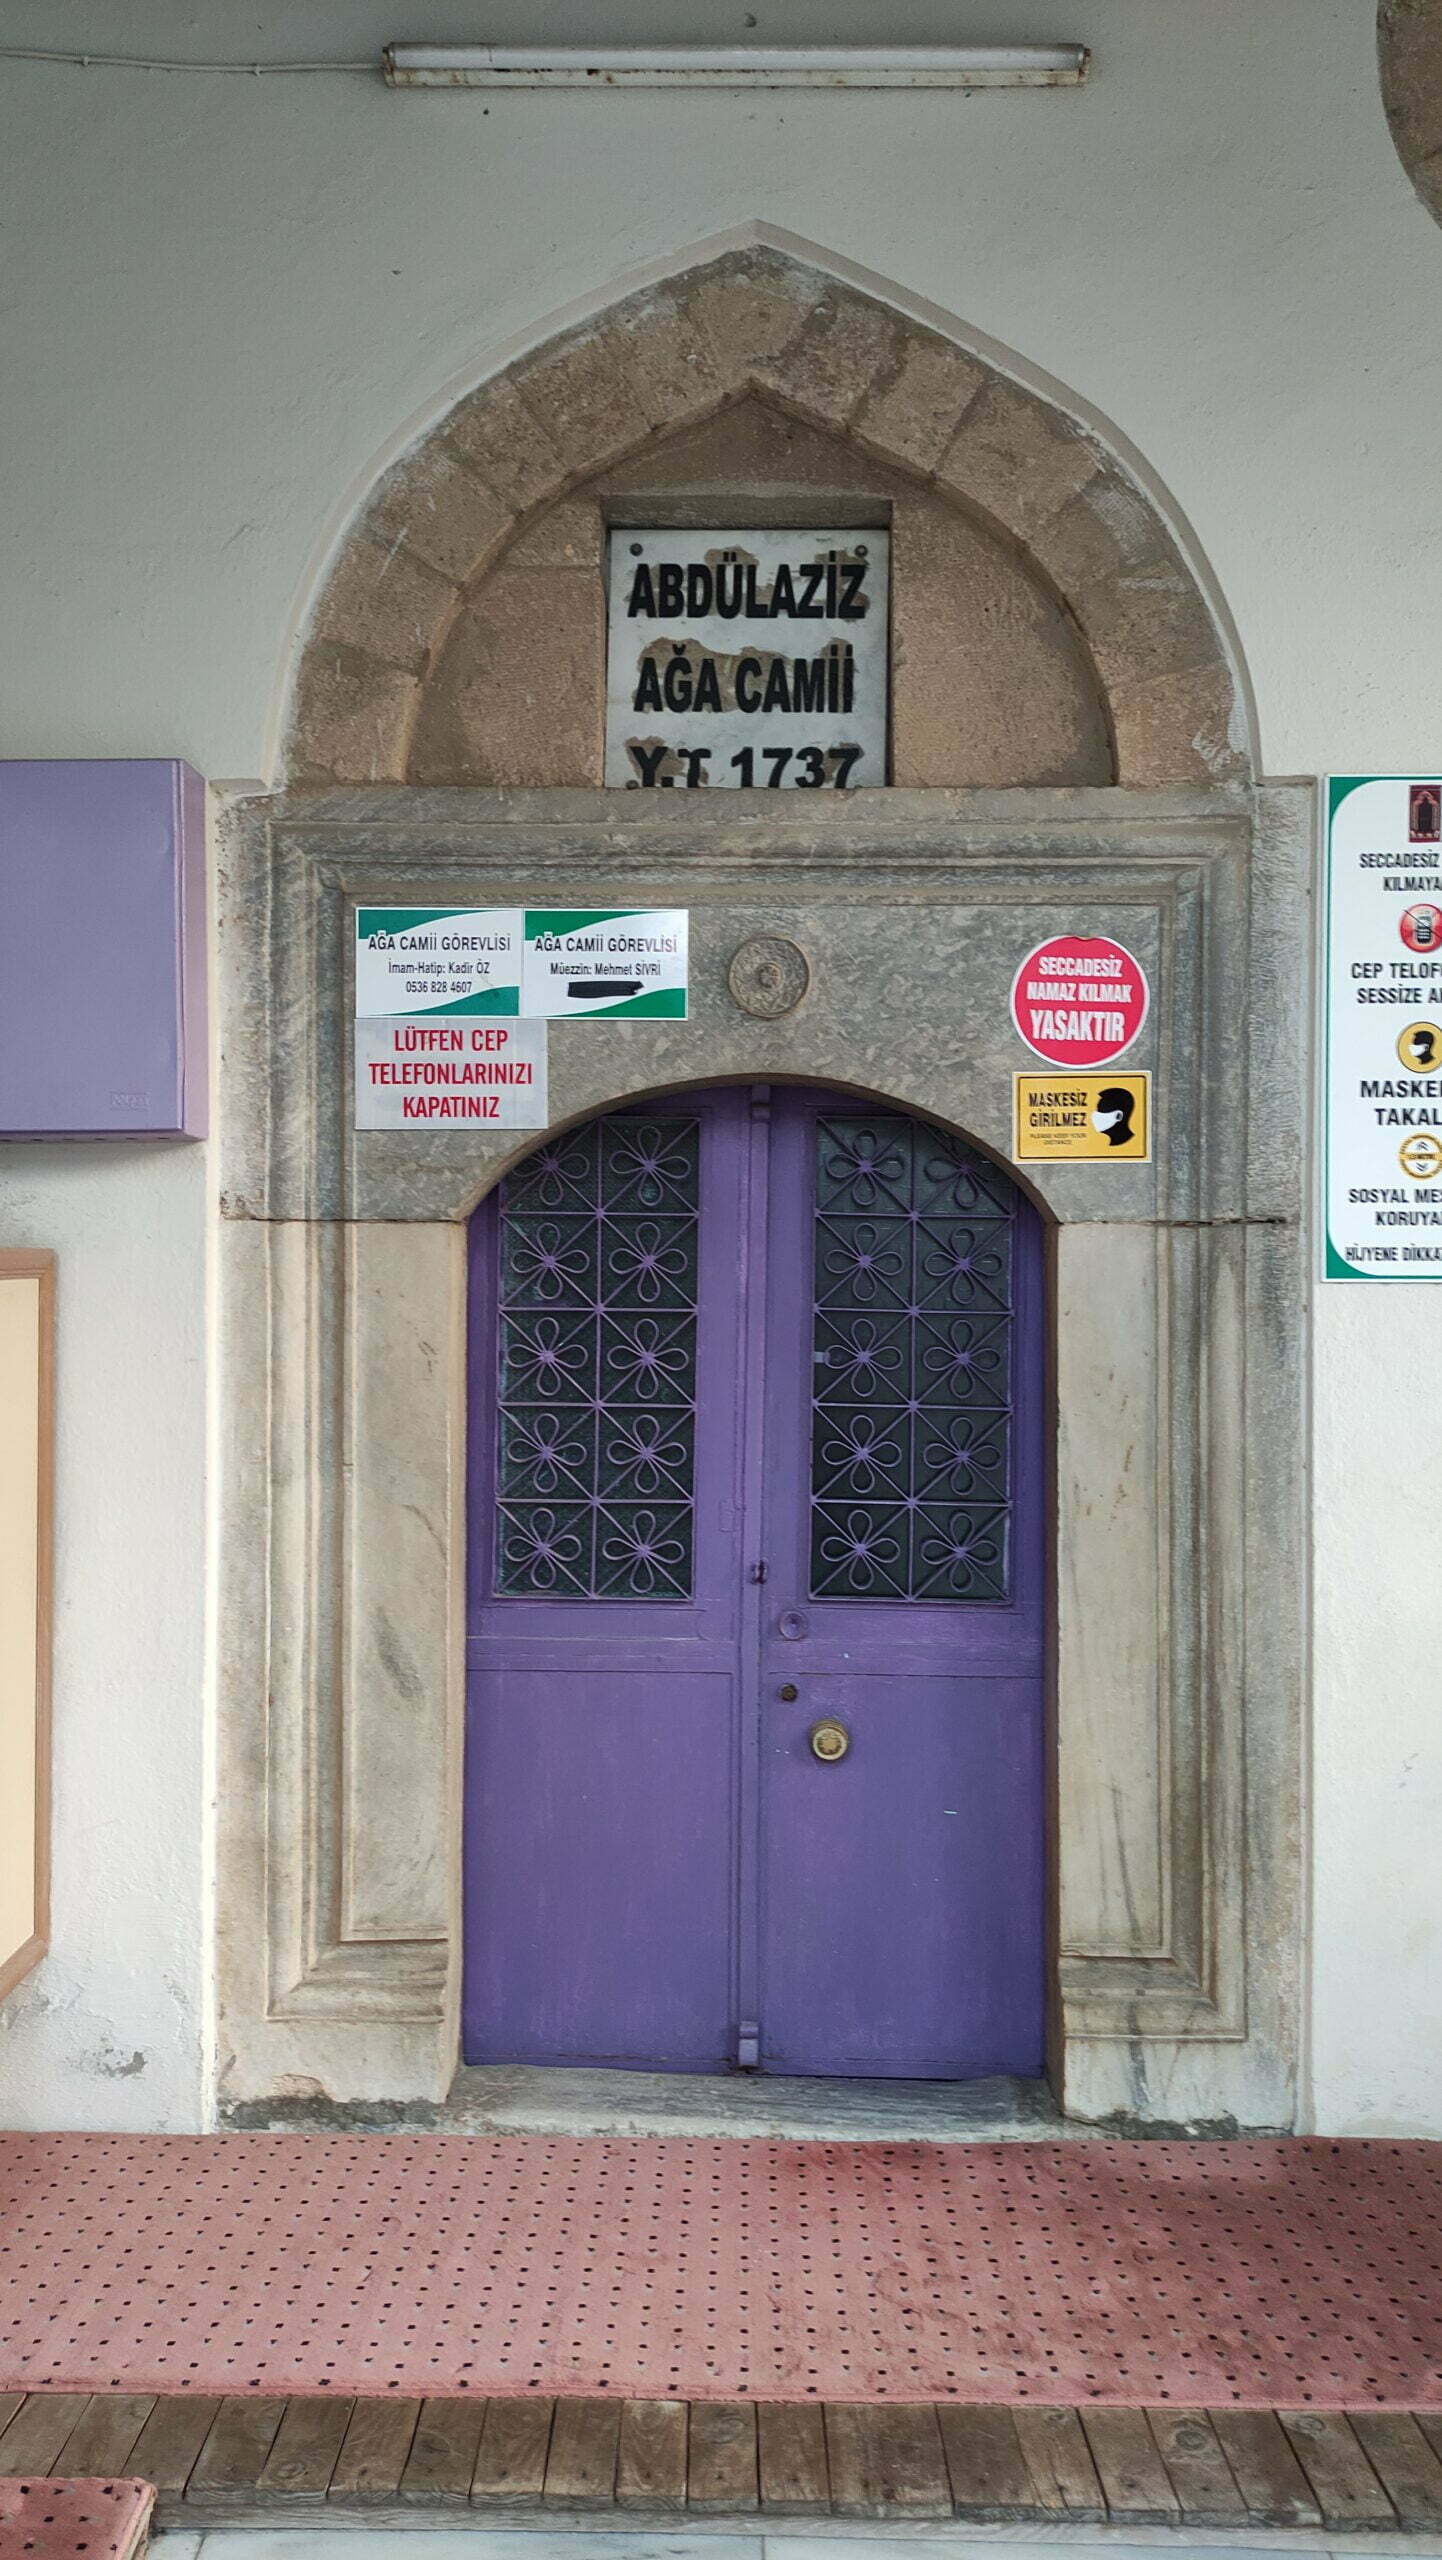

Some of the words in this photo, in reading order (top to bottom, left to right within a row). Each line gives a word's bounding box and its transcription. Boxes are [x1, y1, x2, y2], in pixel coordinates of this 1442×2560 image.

[627, 550, 866, 619] ABDÜLAZİZ
[633, 643, 723, 713] AĞA
[735, 644, 854, 713] CAMİİ
[629, 746, 712, 788] Y.T
[731, 746, 864, 788] 1737
[1359, 849, 1440, 868] SECCADESİZ
[1383, 876, 1442, 891] KILMAYA
[368, 932, 396, 950] AĞA
[400, 932, 437, 950] CAMİİ
[441, 932, 511, 951] GÖREVLİSİ
[534, 934, 562, 951] AĞA
[566, 934, 603, 951] CAMİİ
[608, 934, 677, 952] GÖREVLİSİ
[388, 957, 446, 976] İmam-Hatip:
[448, 961, 473, 974] Kadir
[476, 958, 490, 974] ÖZ
[550, 961, 591, 975] Müezzin:
[594, 962, 633, 975] Mehmet
[635, 960, 661, 976] SİVRİ
[1039, 955, 1123, 977] SECCADESİZ
[1351, 963, 1383, 979] CEP
[1390, 962, 1442, 978] TELOF
[406, 981, 428, 993] 0536
[431, 981, 447, 993] 828
[450, 981, 472, 993] 4607
[1027, 982, 1076, 1001] NAMAZ
[1078, 983, 1132, 1003] KILMAK
[1357, 983, 1422, 1003] SESSİZE
[1428, 988, 1442, 1003] A
[1030, 1009, 1125, 1042] YASAKTIR
[394, 1025, 463, 1051] LÜTFEN
[472, 1029, 508, 1051] CEP
[368, 1063, 533, 1085] TELEFONLARINIZI
[1028, 1088, 1088, 1107] MASKESİZ
[1360, 1080, 1442, 1098] MASKE
[402, 1096, 500, 1118] KAPATINIZ
[1030, 1109, 1087, 1127] GİRİLMEZ
[1349, 1188, 1409, 1203] SOSYAL
[1414, 1188, 1442, 1203] ME
[1375, 1211, 1442, 1226] KORUYA
[1345, 1243, 1399, 1261] HİJYENE
[1402, 1243, 1442, 1261] DİKKA
